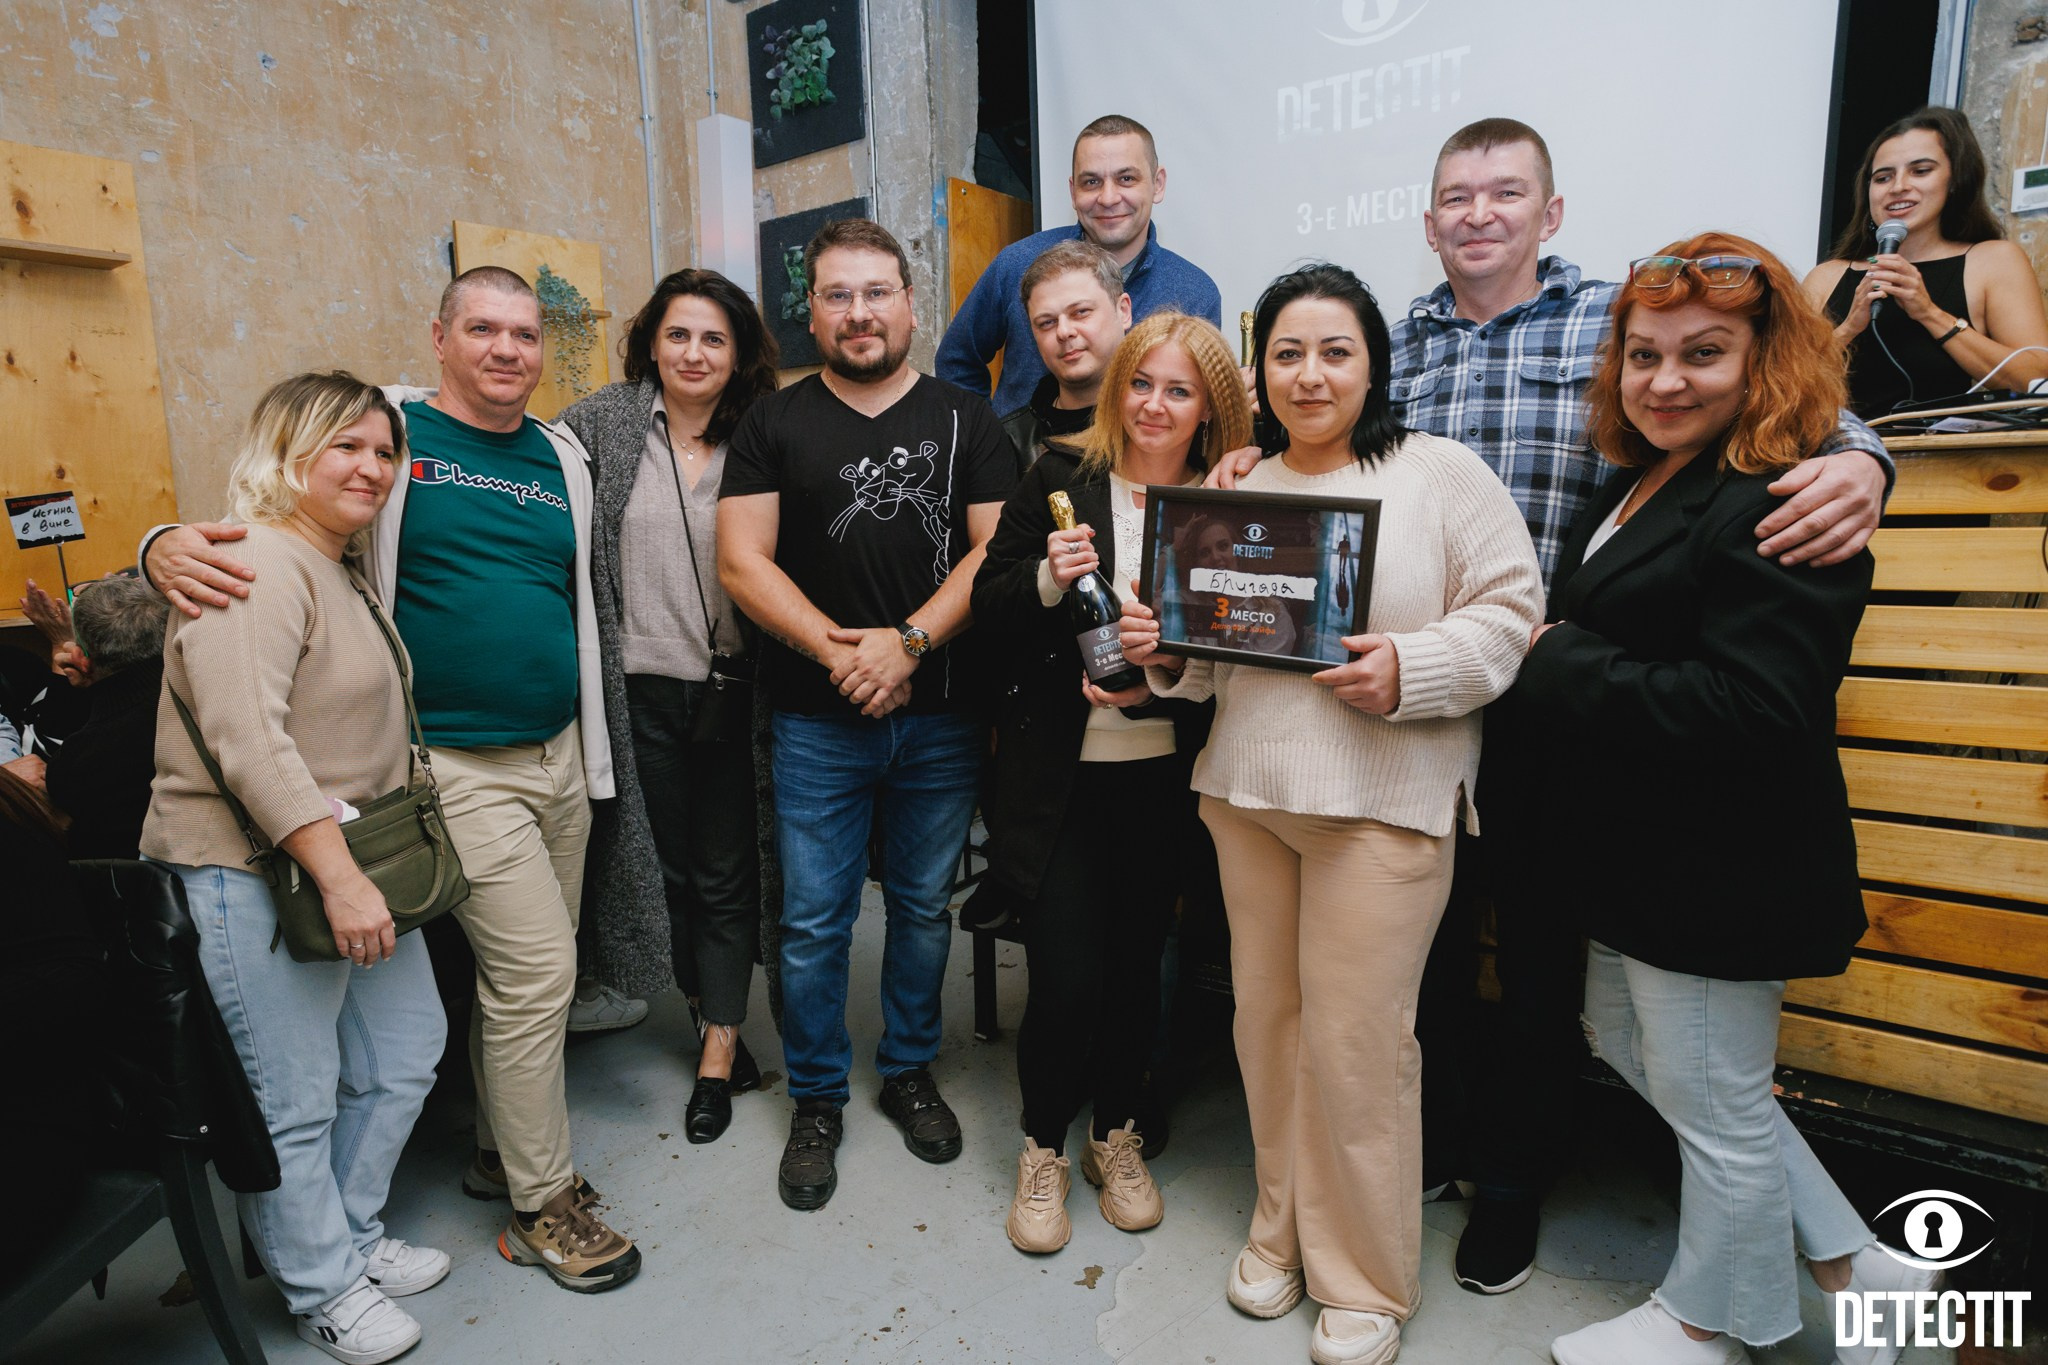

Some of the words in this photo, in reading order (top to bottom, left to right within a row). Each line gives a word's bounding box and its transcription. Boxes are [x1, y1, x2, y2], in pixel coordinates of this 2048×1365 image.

[1276, 45, 1472, 144] DETECTIT
[411, 457, 568, 511] Champion
[1232, 543, 1275, 560] DETECTIT
[1214, 597, 1230, 618] 3
[1230, 609, 1276, 625] МЕСТО
[1107, 652, 1123, 663] Мес
